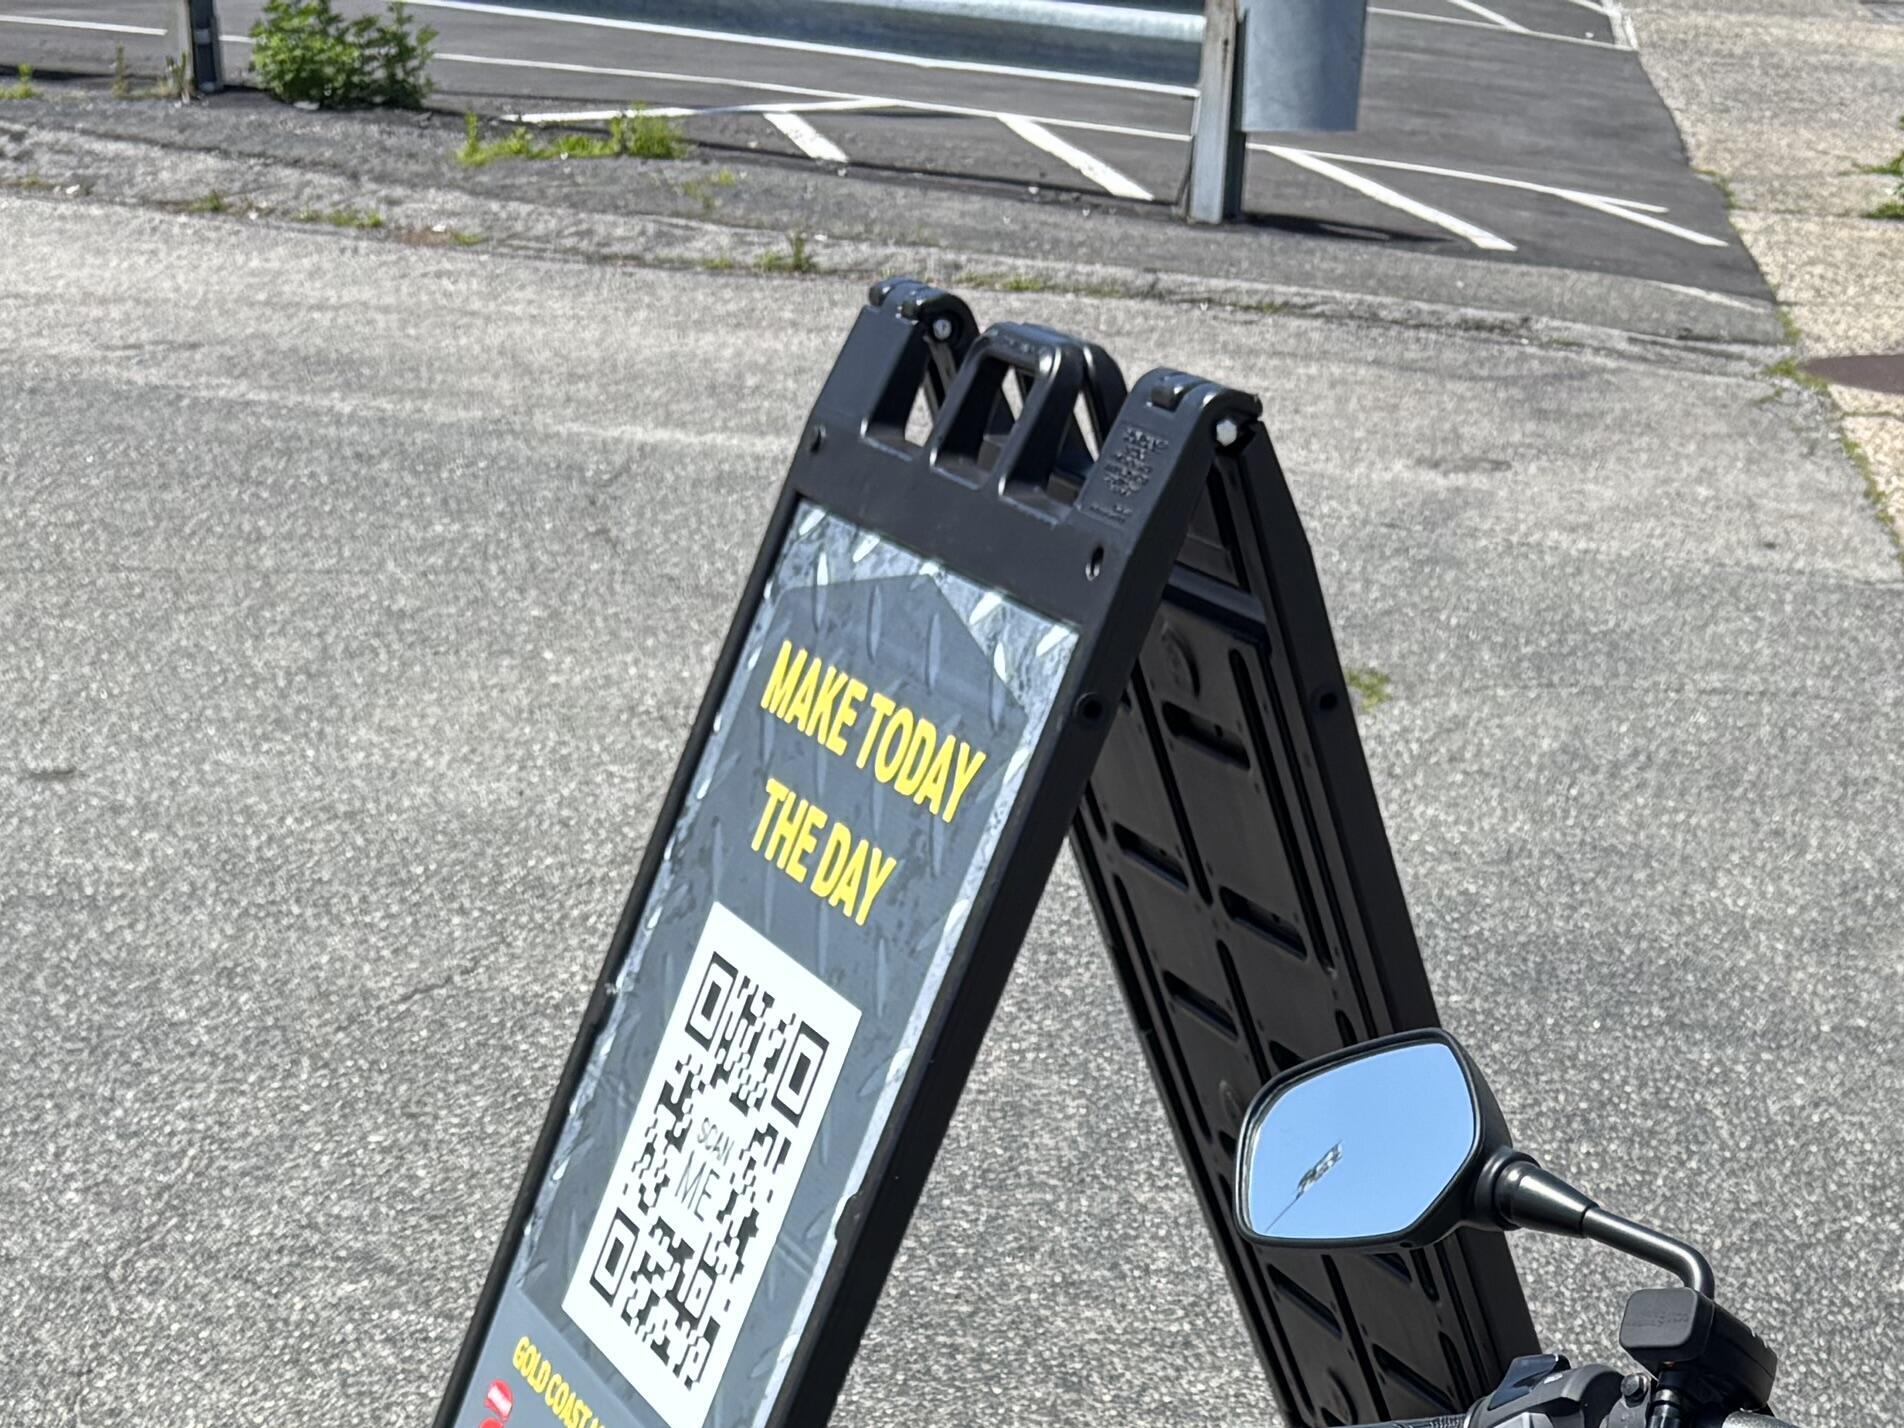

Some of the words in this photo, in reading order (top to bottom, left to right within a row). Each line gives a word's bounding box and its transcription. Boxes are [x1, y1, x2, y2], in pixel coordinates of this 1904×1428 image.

[760, 640, 868, 754] MAKE
[856, 692, 987, 824] TODAY
[750, 779, 828, 884] THE
[809, 830, 898, 926] DAY
[697, 1116, 736, 1167] SCAN
[674, 1149, 721, 1223] ME
[512, 1336, 551, 1396] GOLD
